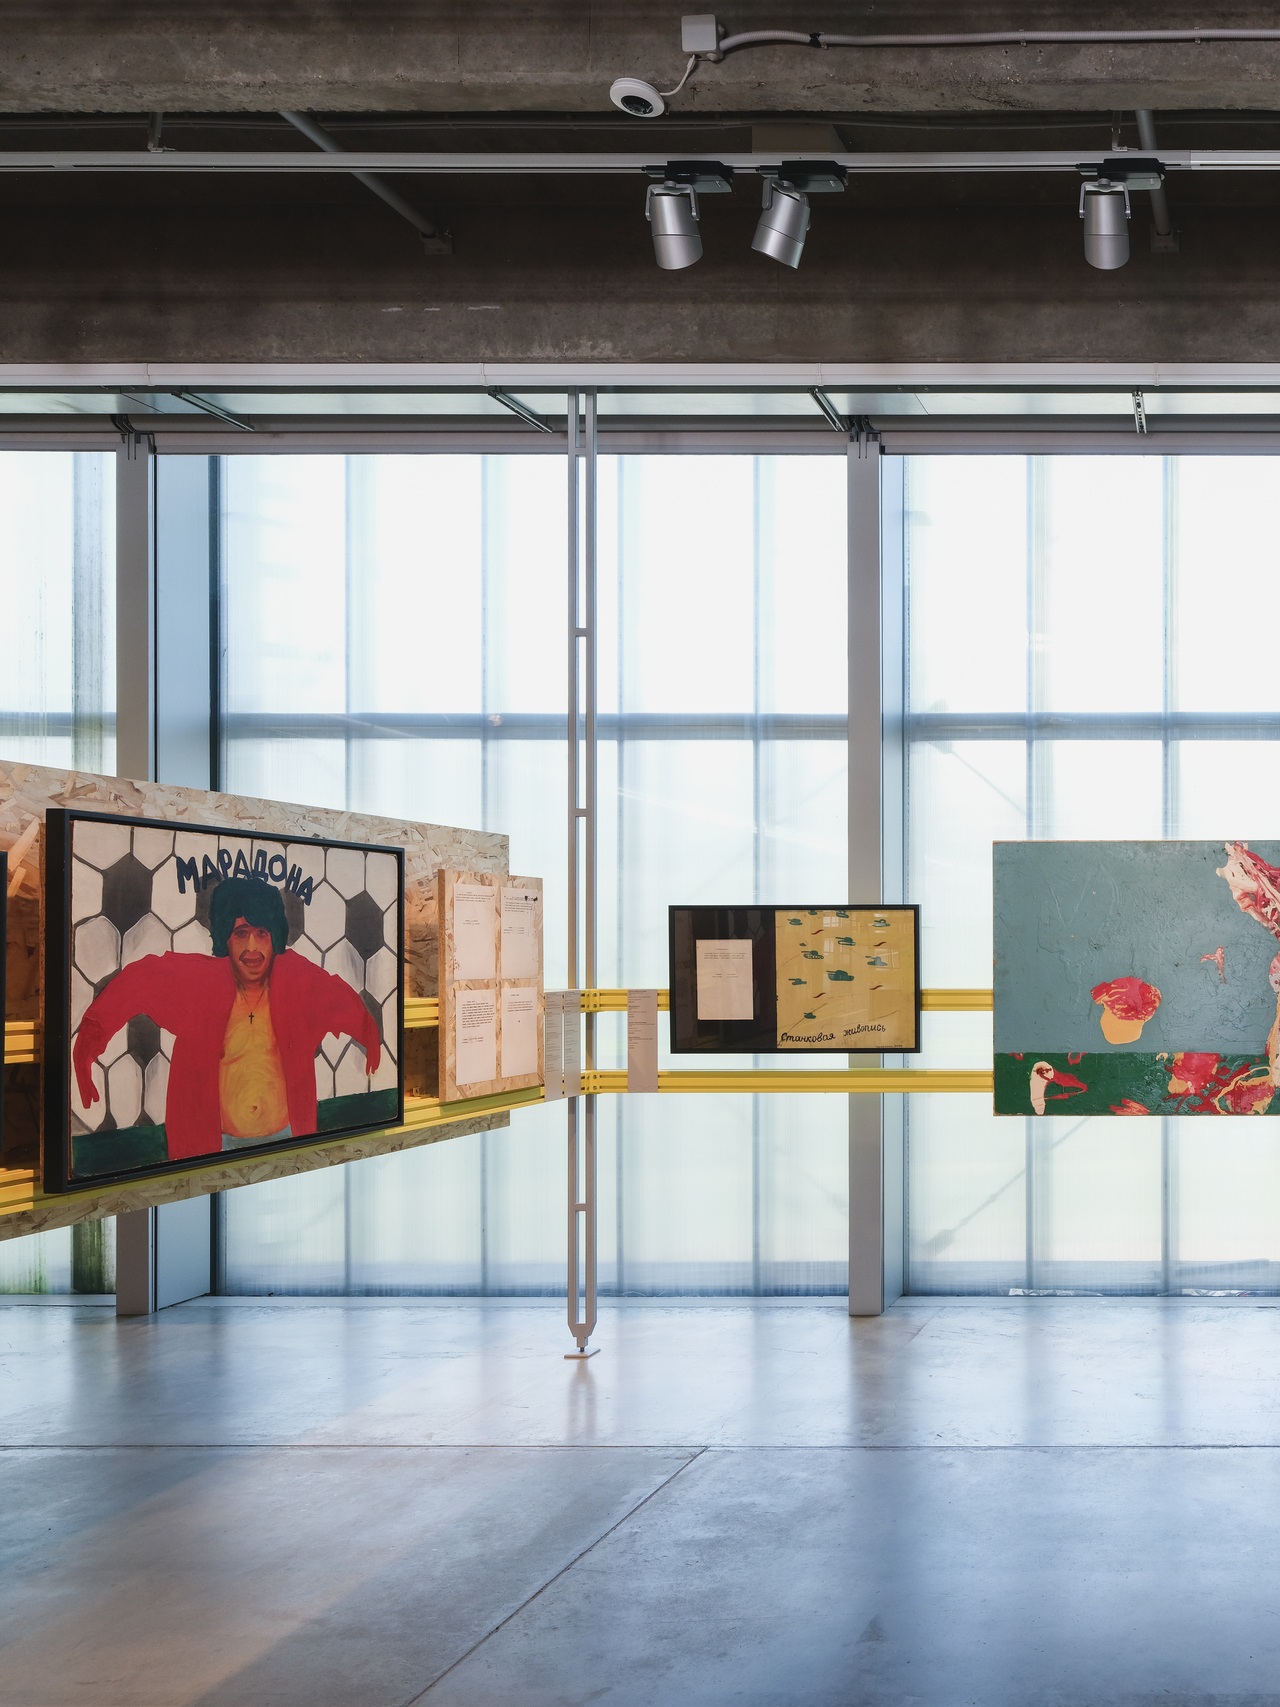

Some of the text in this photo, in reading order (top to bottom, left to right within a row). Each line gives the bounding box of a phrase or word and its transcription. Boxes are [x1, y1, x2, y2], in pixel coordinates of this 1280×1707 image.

[176, 848, 313, 906] МАРАДОНА
[780, 1024, 886, 1043] Станковая живопись
